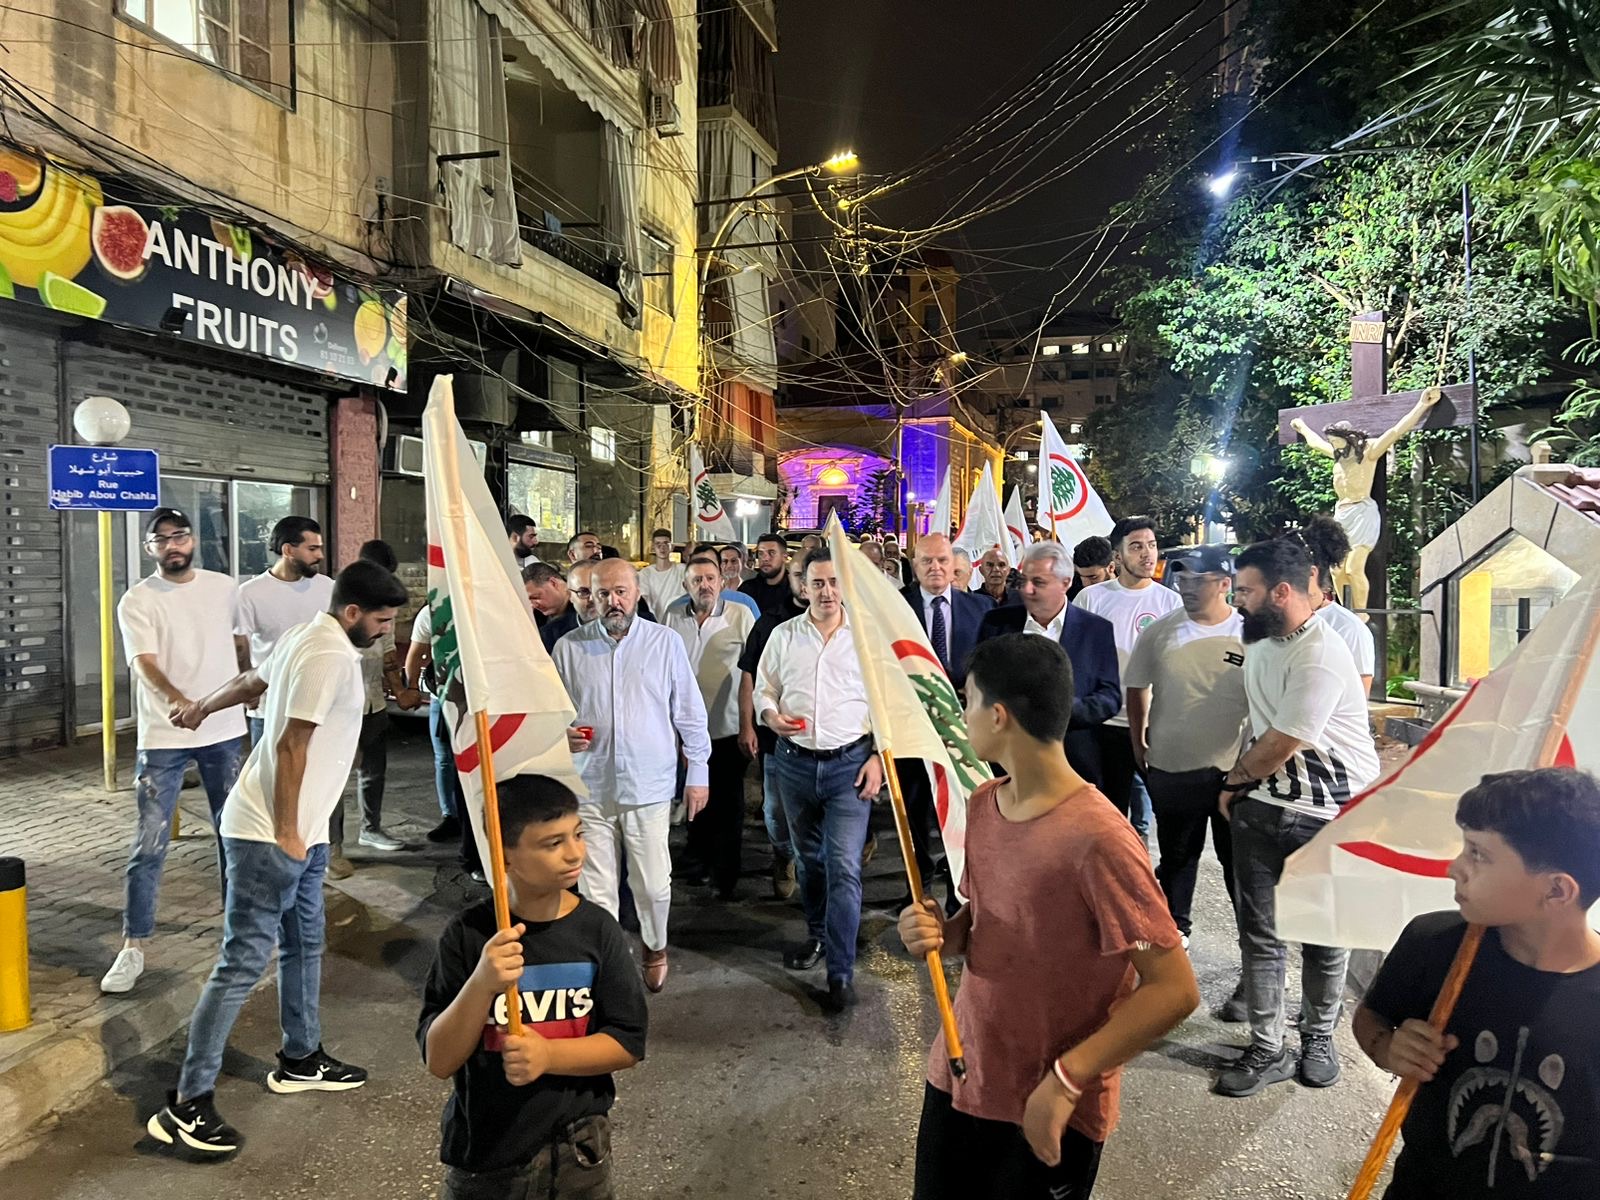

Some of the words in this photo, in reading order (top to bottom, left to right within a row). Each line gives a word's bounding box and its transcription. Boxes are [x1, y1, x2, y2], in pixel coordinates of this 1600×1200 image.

[141, 220, 319, 310] ANTHONY
[91, 452, 118, 462] شارع
[69, 464, 96, 475] شهلا
[97, 463, 111, 476] أبو
[112, 469, 144, 477] حبيب
[98, 480, 119, 489] Rue
[52, 489, 84, 499] Habib
[88, 490, 116, 499] Abou
[120, 491, 157, 500] Chahla
